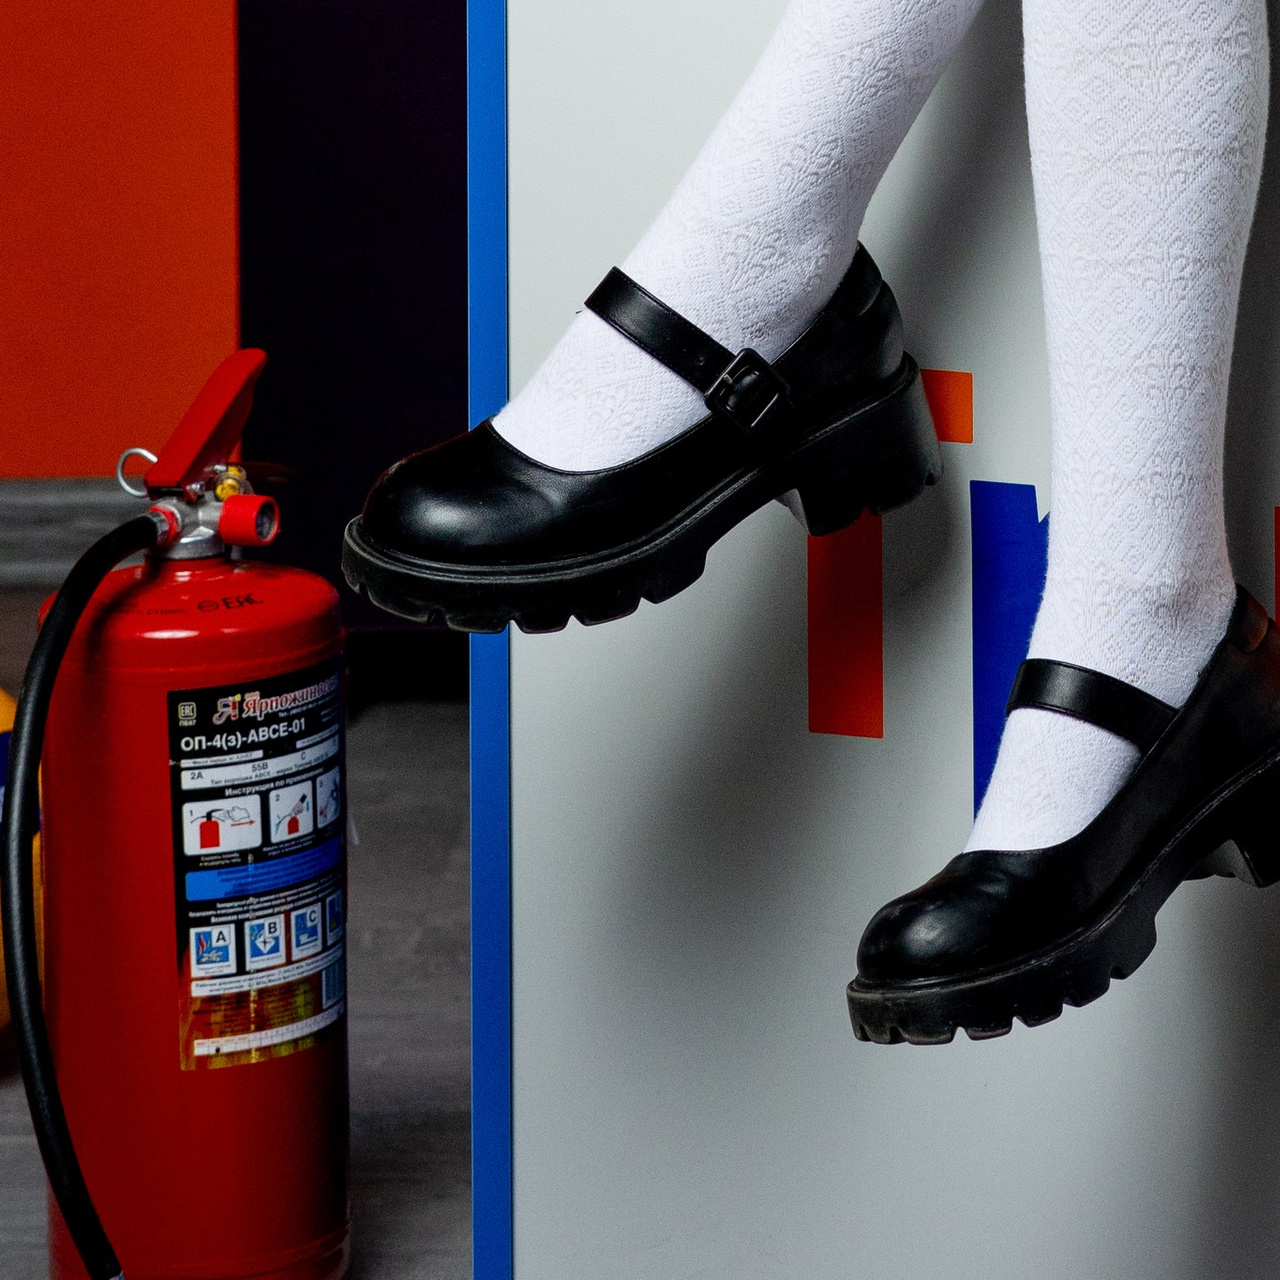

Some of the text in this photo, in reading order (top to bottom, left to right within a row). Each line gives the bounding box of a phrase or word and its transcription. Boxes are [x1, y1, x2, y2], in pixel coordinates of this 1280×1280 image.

[309, 910, 317, 922] C
[268, 922, 277, 934] B
[216, 931, 227, 943] A
